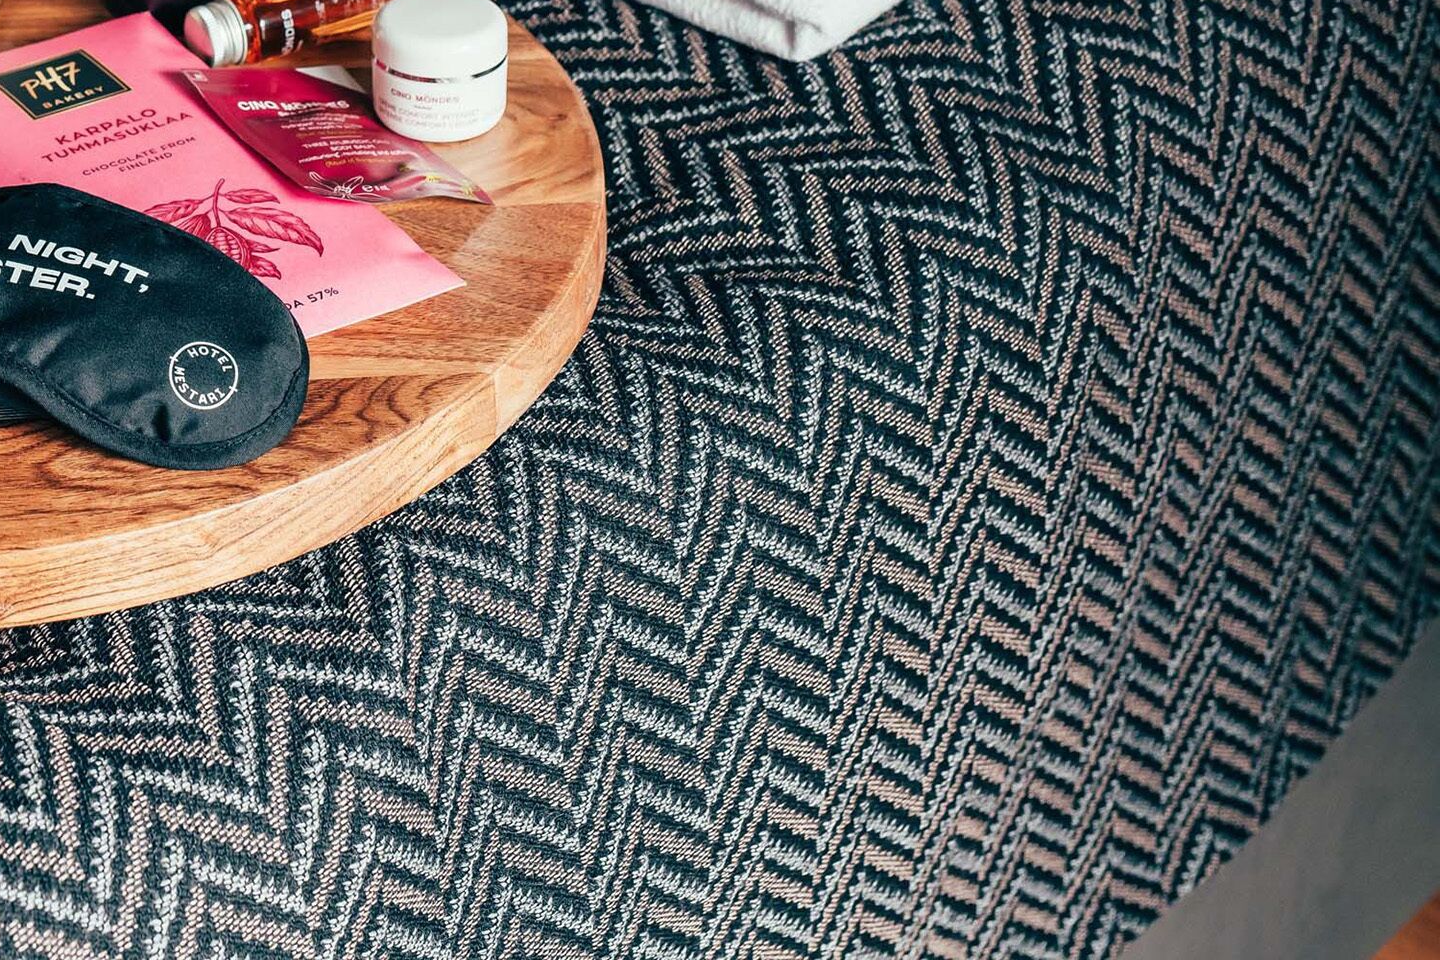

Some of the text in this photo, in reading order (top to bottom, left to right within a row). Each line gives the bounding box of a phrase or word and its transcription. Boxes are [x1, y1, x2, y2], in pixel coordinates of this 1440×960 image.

[42, 86, 105, 109] BAKERY
[237, 100, 280, 111] CINQ
[42, 112, 194, 163] TUMMASUKLAA
[55, 108, 158, 145] KARPALO
[82, 136, 196, 176] CHOCOLATE FROM
[118, 151, 173, 173] FINLAND
[8, 234, 150, 293] NIGHT,
[307, 287, 339, 303] 57%
[187, 345, 233, 372] HOTEL
[174, 365, 226, 405] MESTARI
